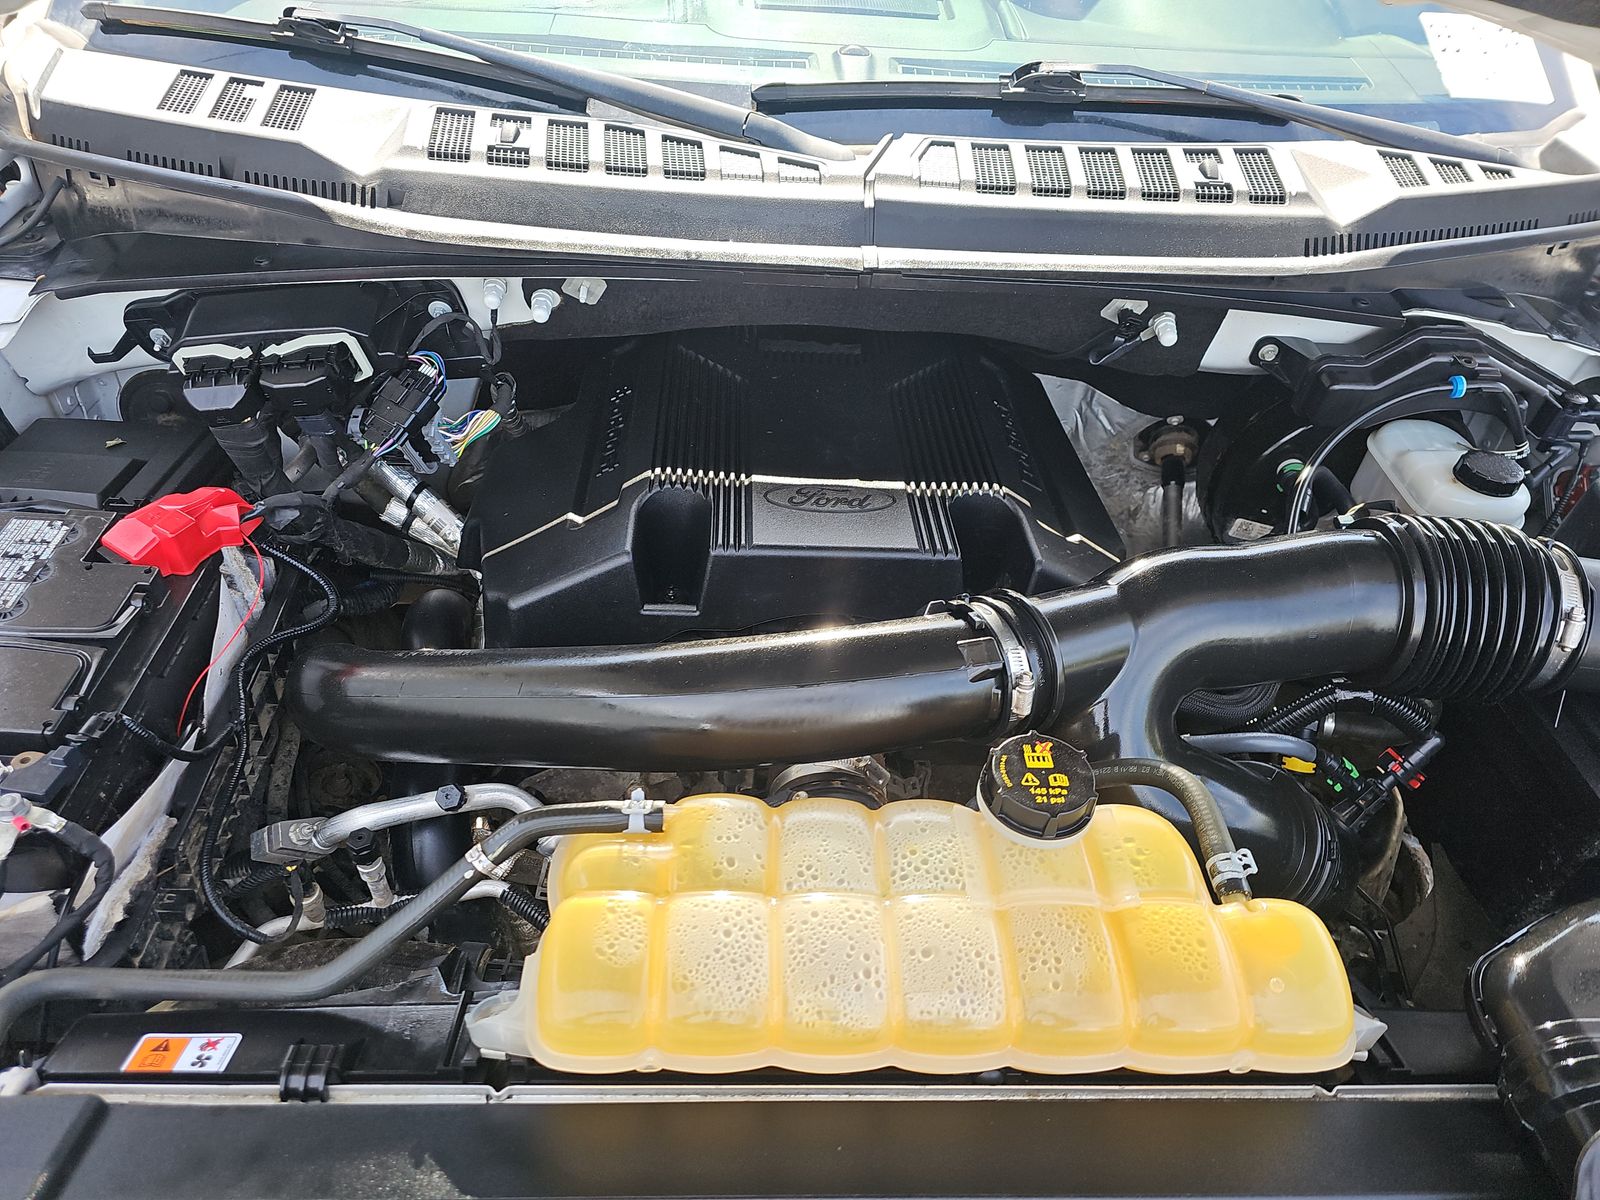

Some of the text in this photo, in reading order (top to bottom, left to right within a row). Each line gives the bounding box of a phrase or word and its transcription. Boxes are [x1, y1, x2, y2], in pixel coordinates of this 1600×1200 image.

[787, 487, 872, 509] Ford
[1029, 786, 1068, 795] 145 kPa
[1035, 795, 1066, 805] 21 psi
